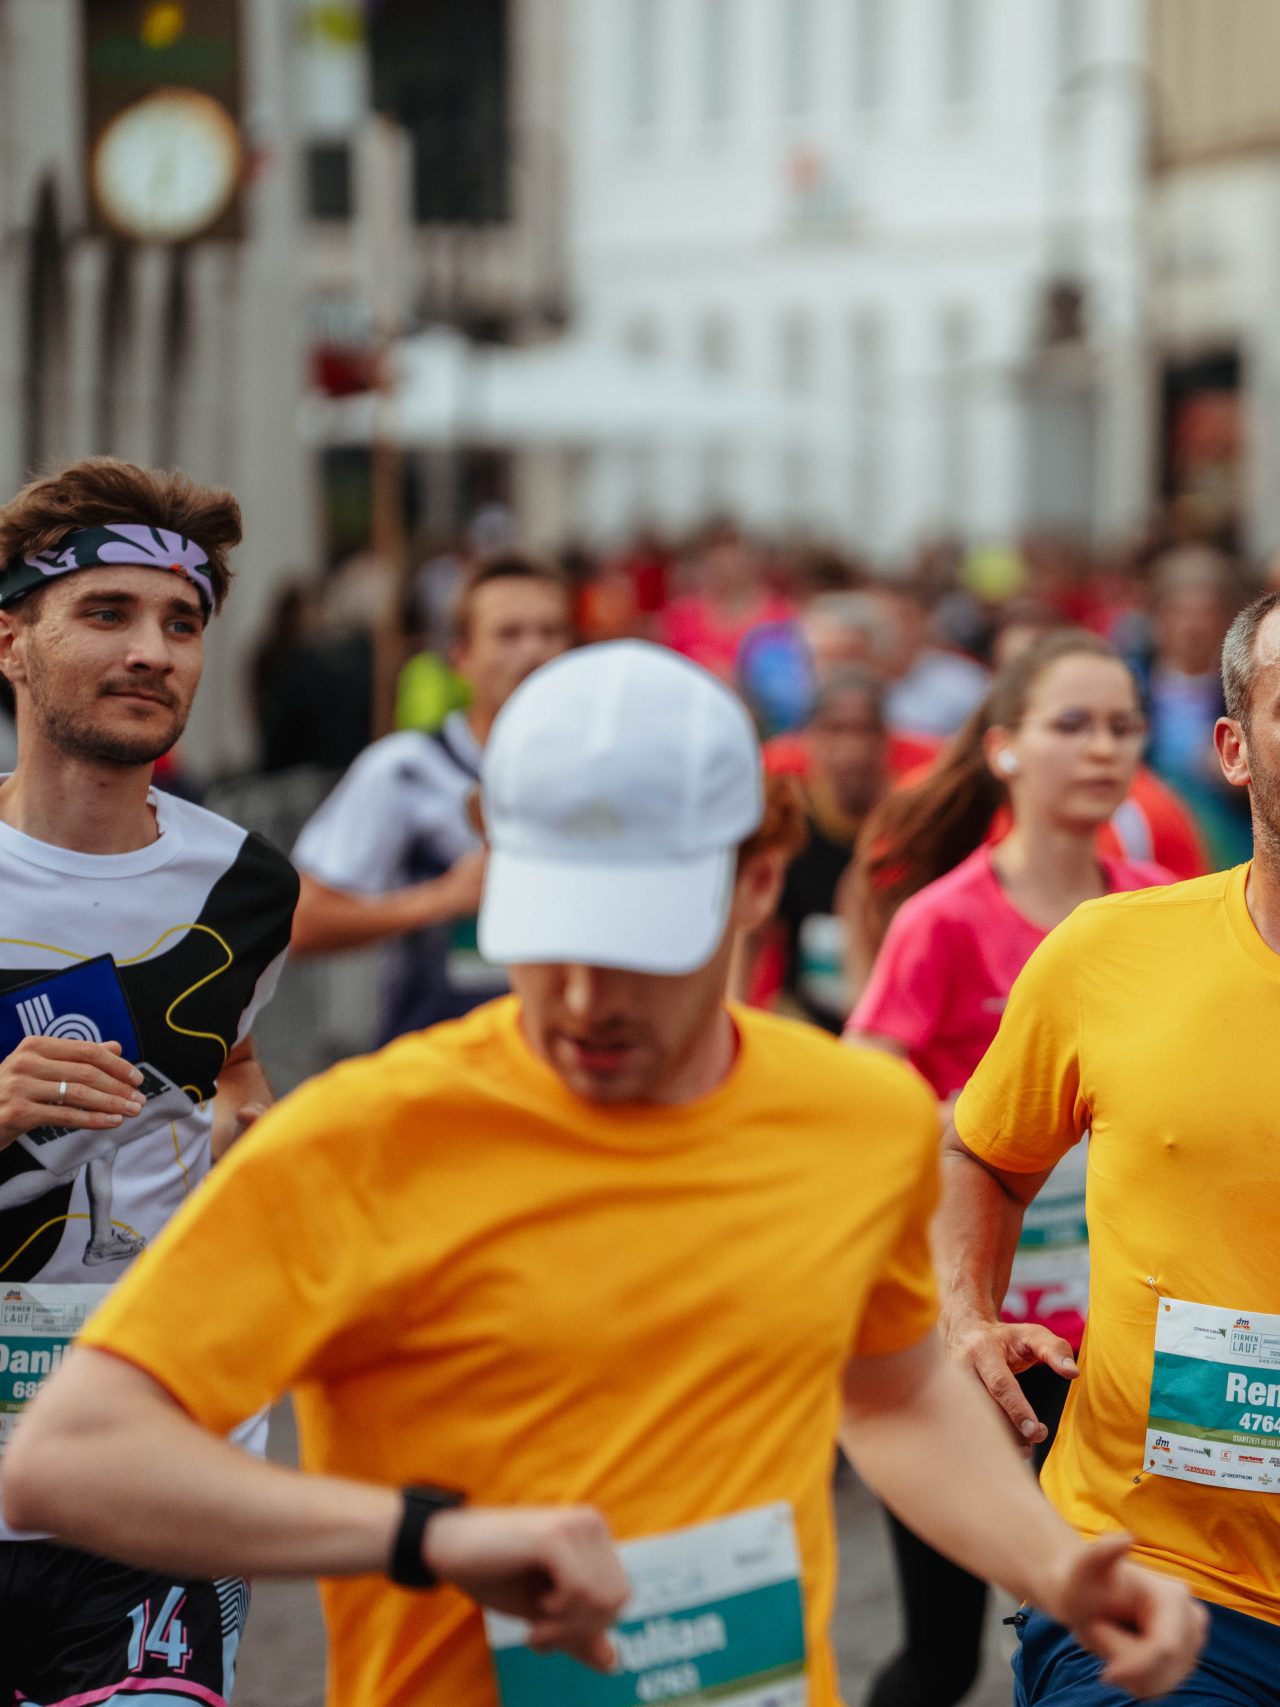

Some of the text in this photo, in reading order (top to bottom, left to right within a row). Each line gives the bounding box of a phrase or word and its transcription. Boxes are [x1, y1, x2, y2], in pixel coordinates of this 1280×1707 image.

[4, 1313, 29, 1323] LAUF
[1234, 1333, 1258, 1342] FIRMEN
[1233, 1342, 1258, 1354] LAUF
[1155, 1436, 1169, 1447] dm
[127, 1586, 190, 1672] 14
